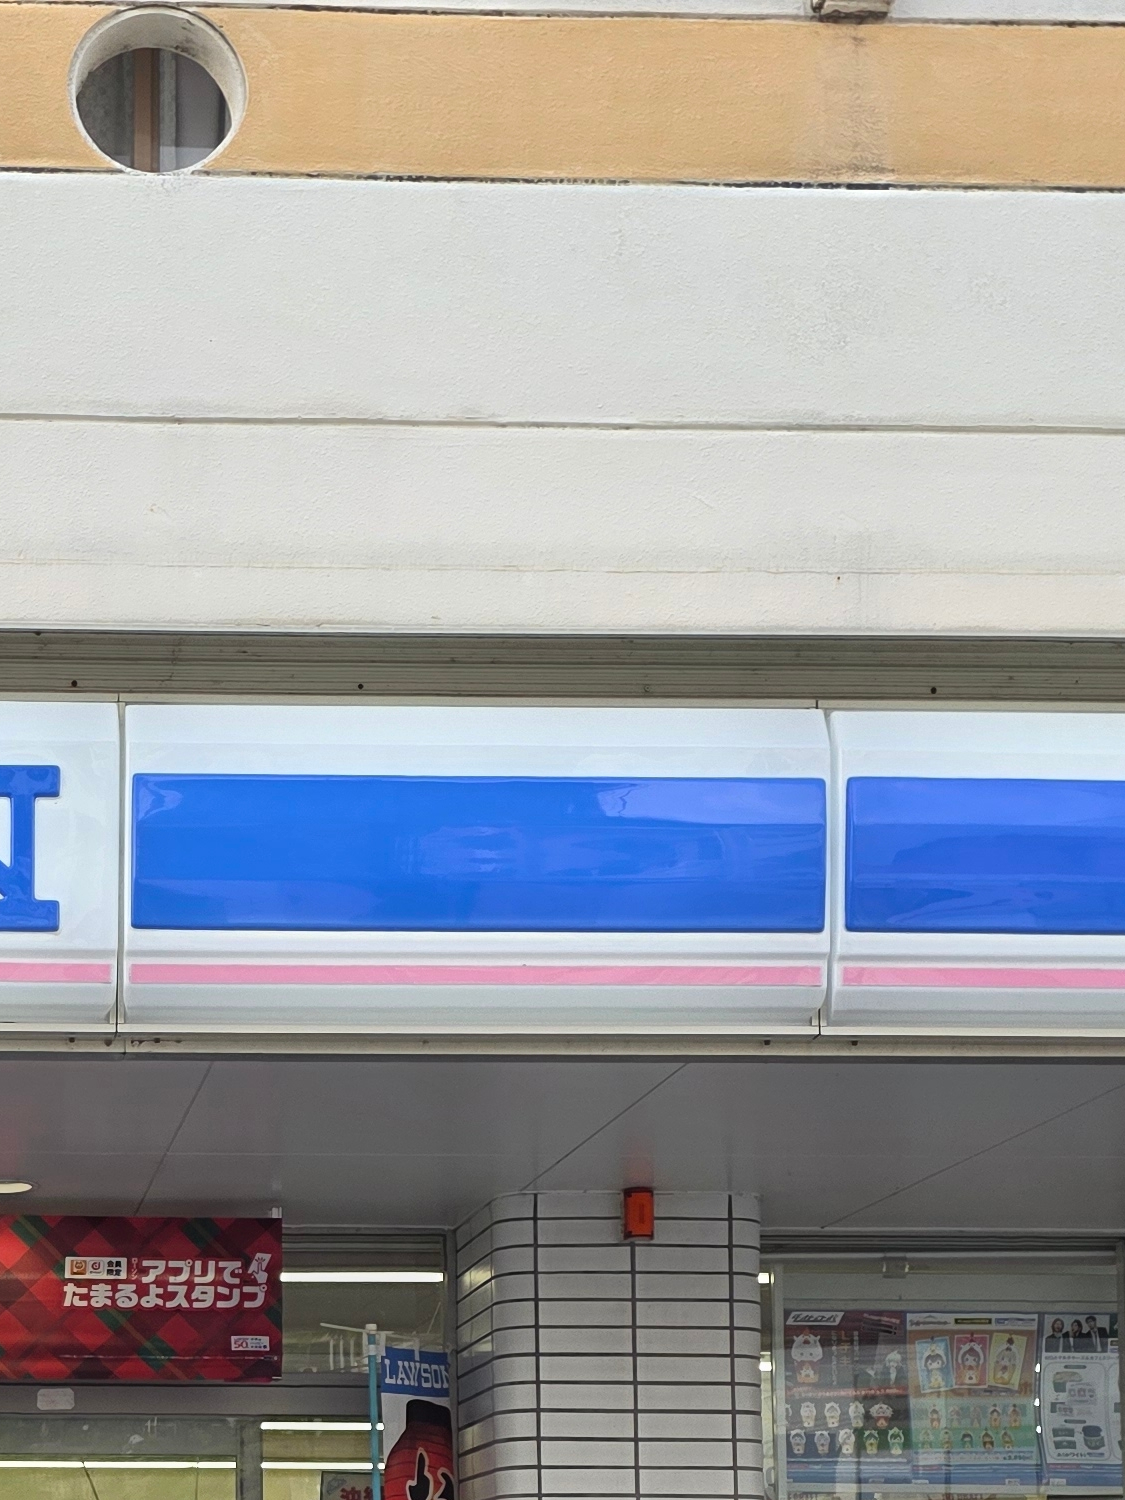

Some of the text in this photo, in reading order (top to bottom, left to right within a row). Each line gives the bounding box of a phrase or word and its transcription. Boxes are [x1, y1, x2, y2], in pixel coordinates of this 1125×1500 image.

[142, 1259, 242, 1284] アプリで
[63, 1283, 268, 1309] たまるよスタンプ
[384, 1359, 449, 1388] LAWSON
